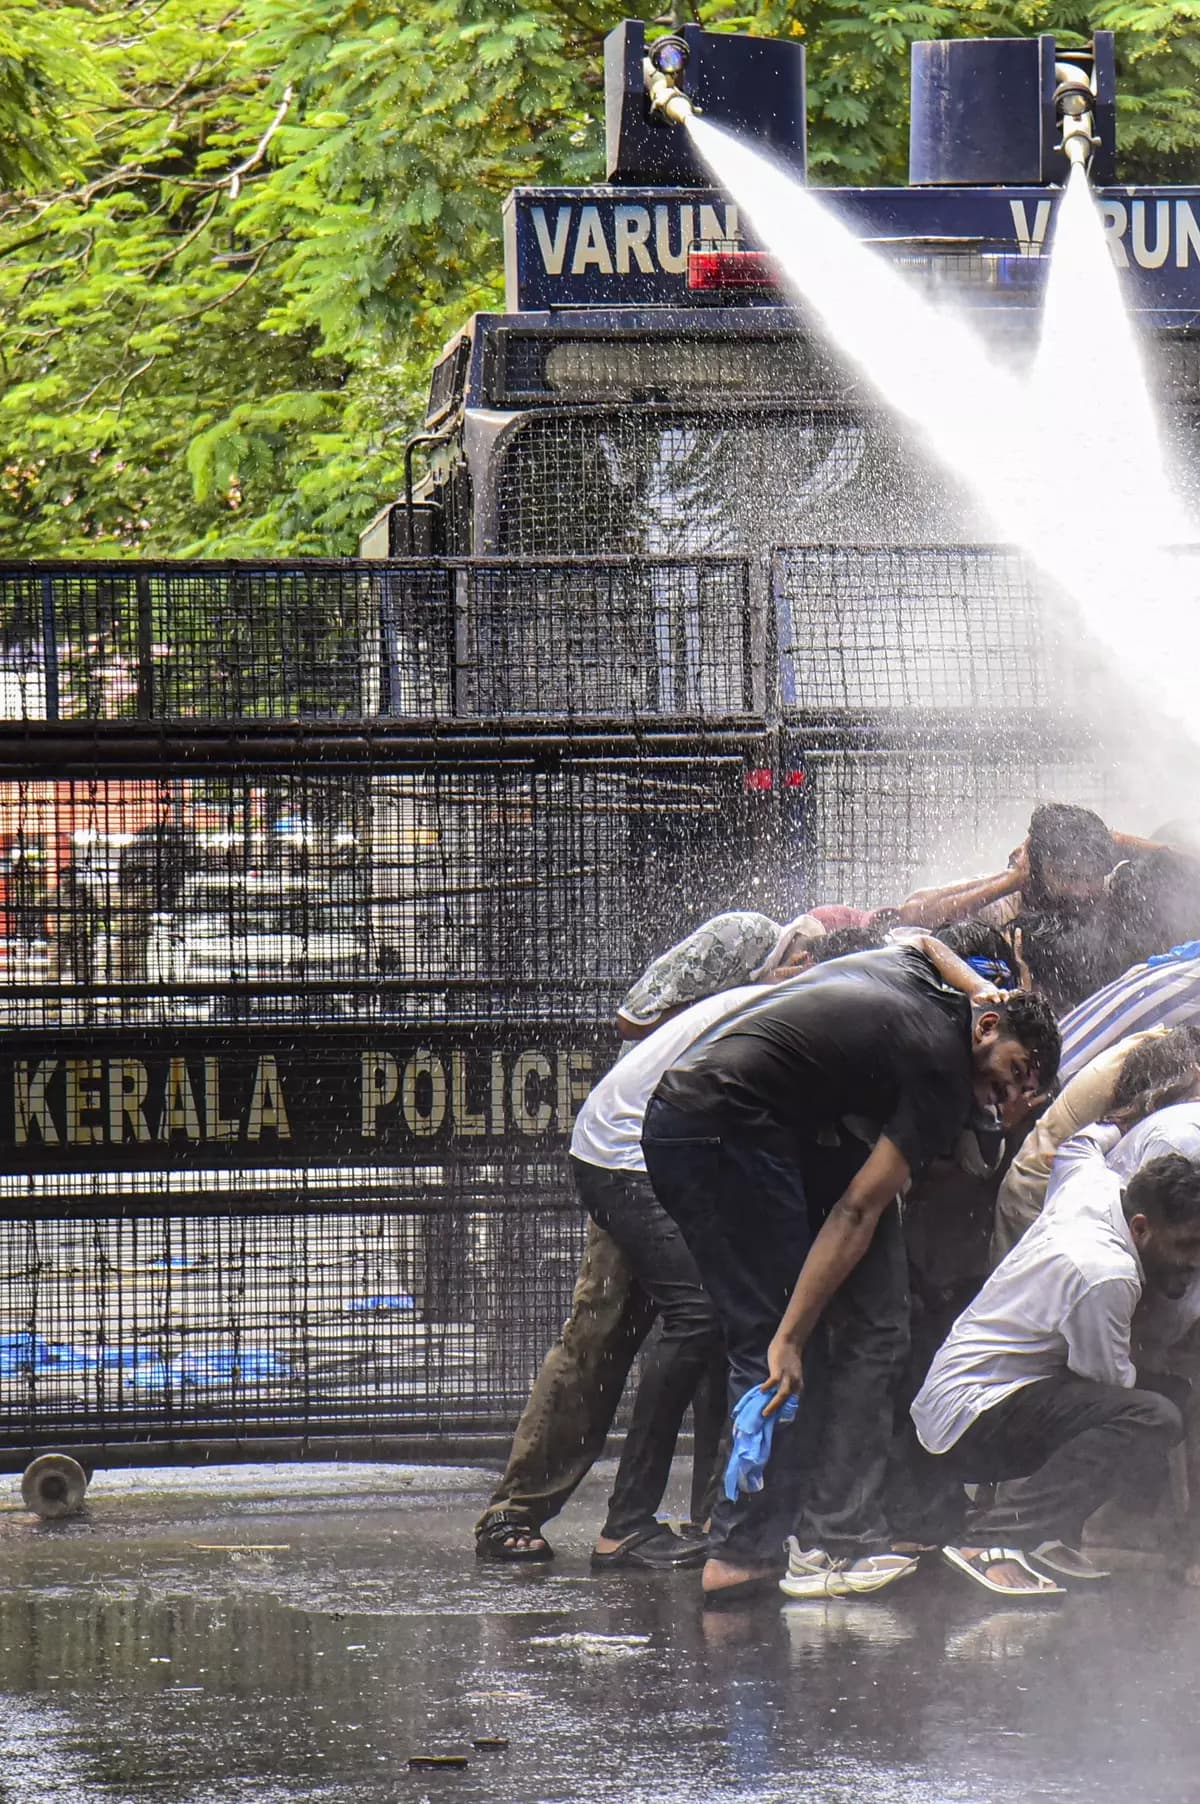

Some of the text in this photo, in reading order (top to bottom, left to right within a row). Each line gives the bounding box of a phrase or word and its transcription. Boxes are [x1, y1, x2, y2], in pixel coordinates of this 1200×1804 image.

[531, 204, 738, 275] VARUN
[14, 1048, 593, 1147] KERALA POLICE
